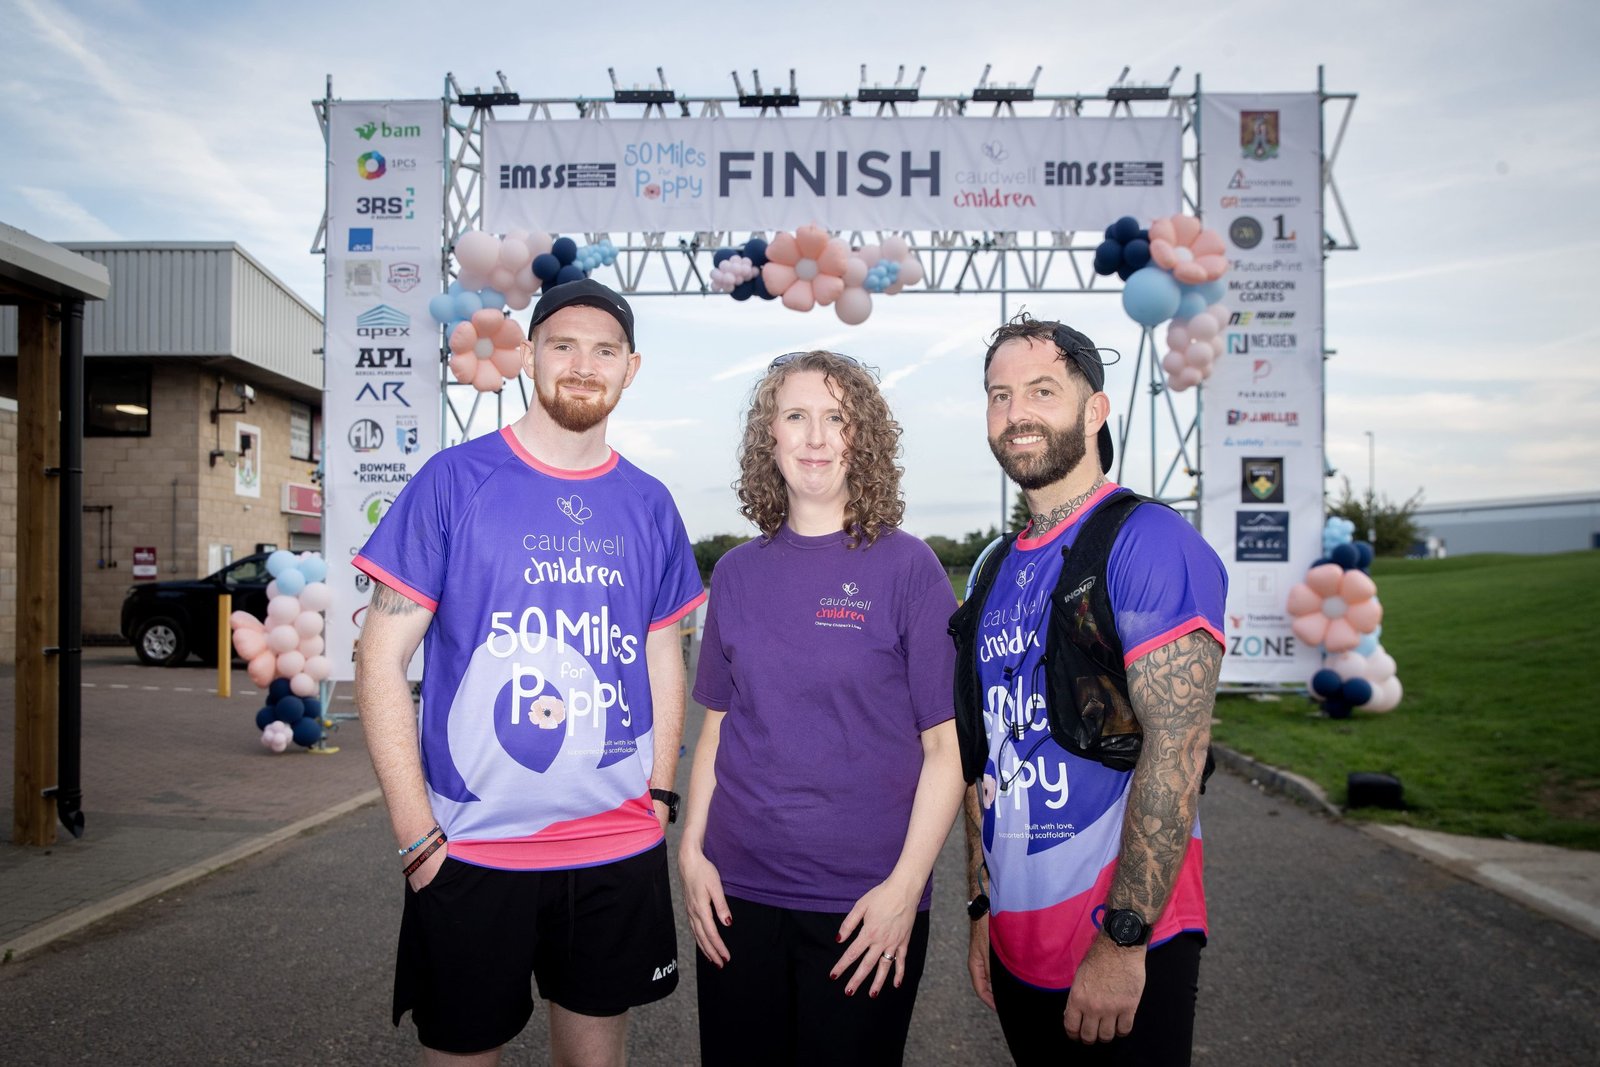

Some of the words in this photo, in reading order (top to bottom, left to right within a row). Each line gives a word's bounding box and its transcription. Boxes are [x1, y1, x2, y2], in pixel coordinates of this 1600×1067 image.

[381, 122, 421, 138] bam
[624, 141, 653, 166] 50
[657, 140, 707, 168] Miles
[391, 159, 416, 168] 1PCS
[719, 150, 941, 198] FINISH
[954, 167, 1037, 185] caudwell
[356, 197, 403, 215] 3RS
[953, 188, 1037, 208] children
[1239, 292, 1285, 303] COATES
[356, 327, 411, 340] apex
[355, 348, 412, 368] APL
[359, 463, 406, 473] BOWMER
[359, 474, 412, 483] KIRKLAND
[523, 530, 625, 557] caudwell
[524, 557, 625, 587] children
[819, 597, 872, 611] caudwell
[815, 607, 865, 623] children
[487, 606, 548, 658] 50
[556, 606, 638, 664] Miles
[1230, 636, 1295, 657] ZONE
[560, 662, 587, 679] for
